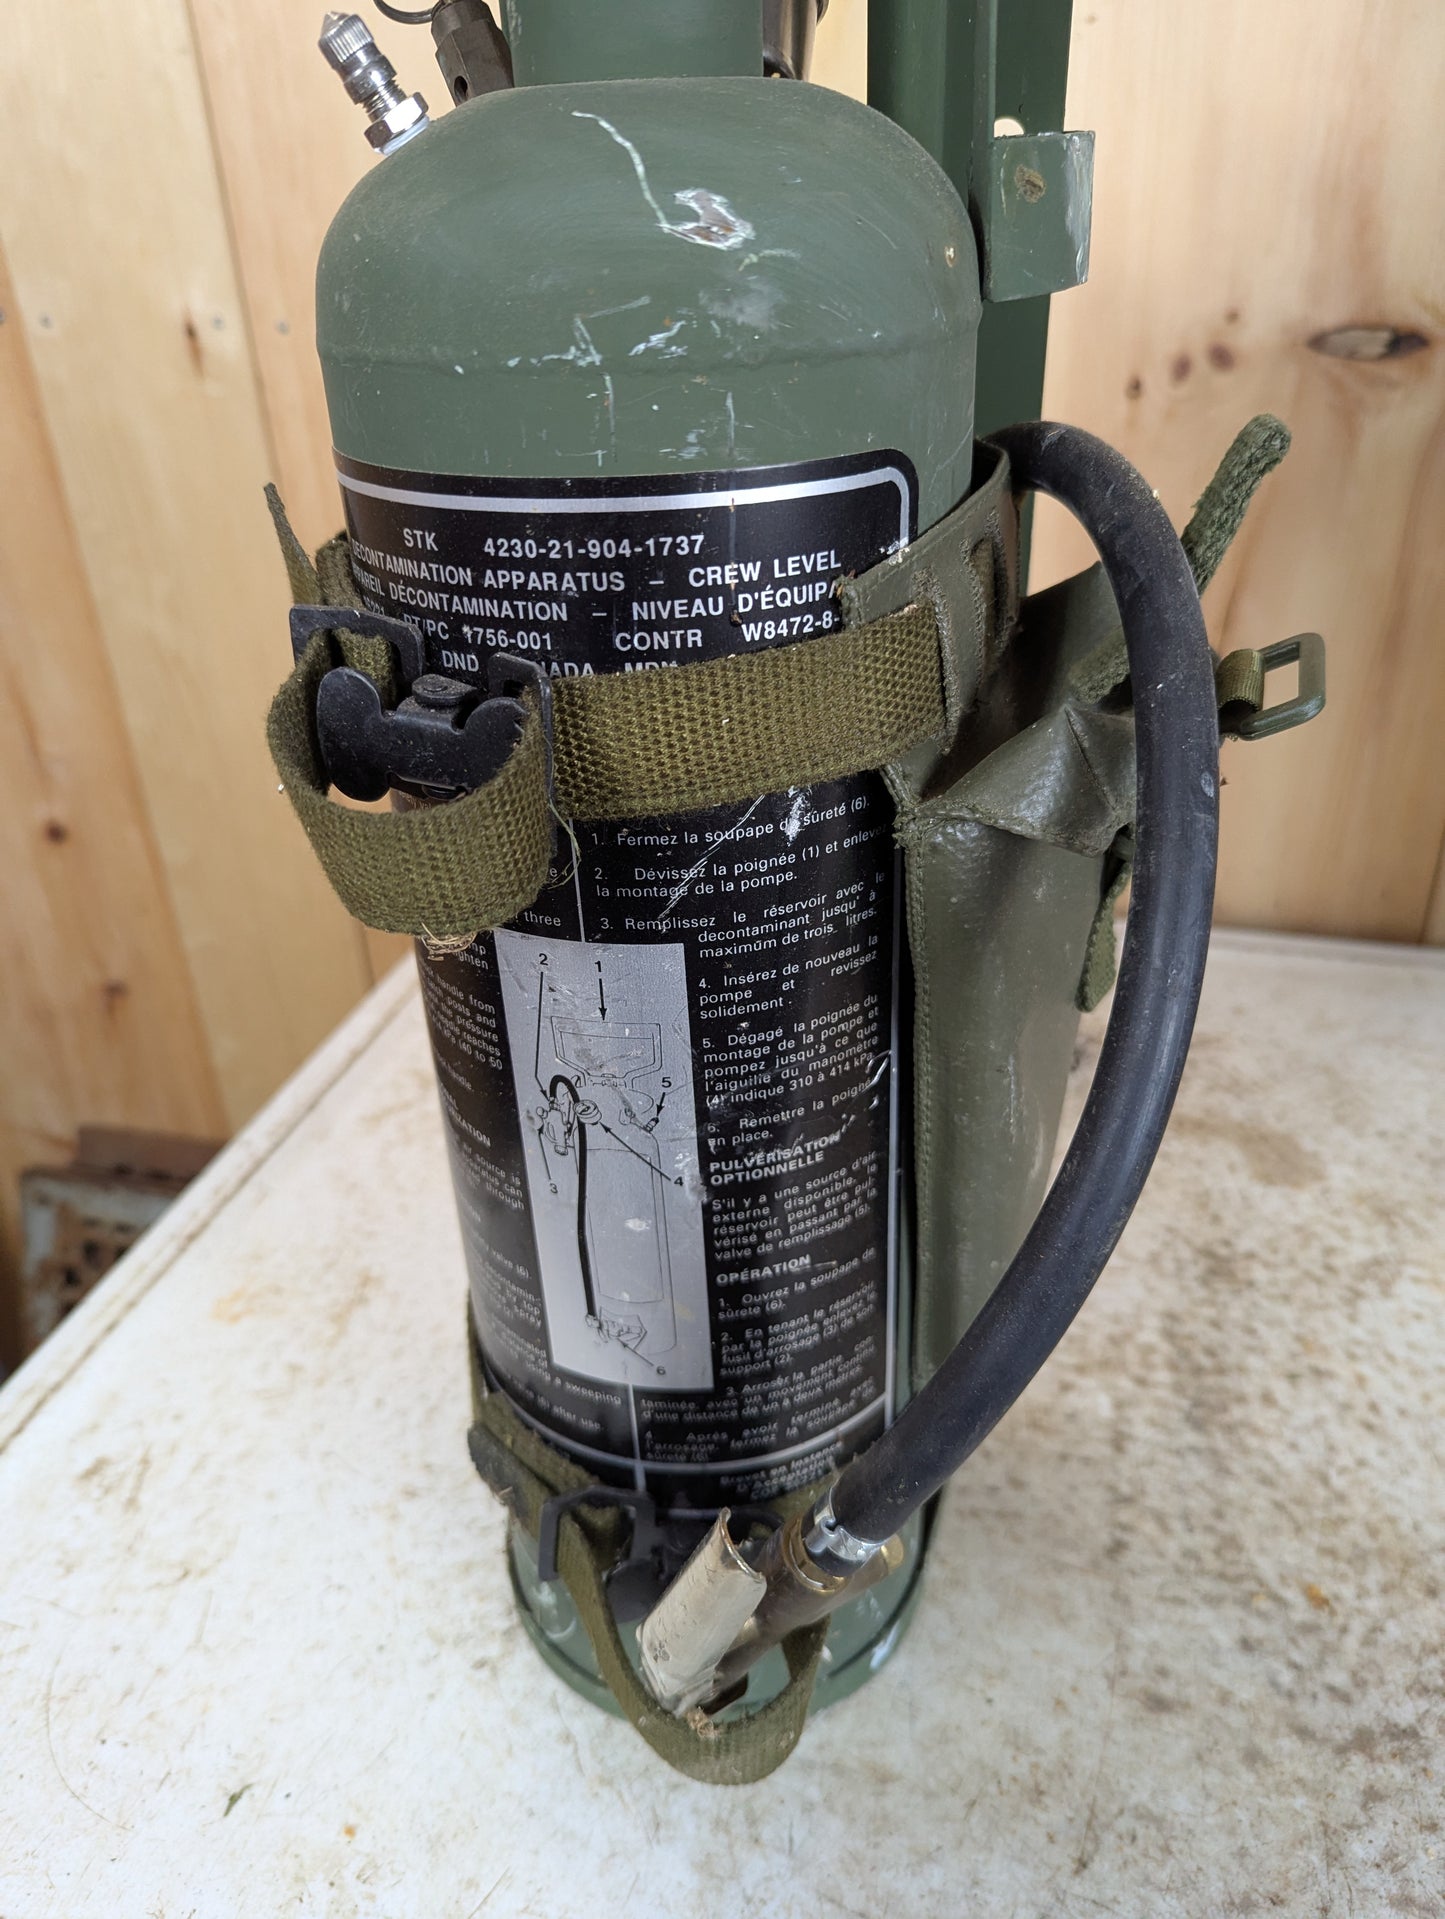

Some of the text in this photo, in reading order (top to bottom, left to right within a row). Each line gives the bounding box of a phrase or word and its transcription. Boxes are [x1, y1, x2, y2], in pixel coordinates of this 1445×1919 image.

[403, 527, 704, 559] STK 4230-21-904-1737
[352, 538, 841, 592] DECONTAMINATION APPARATUS CREW LEVEL
[389, 580, 567, 622] DÉCONTAMINATION
[632, 596, 723, 621] NIVEAU
[615, 629, 703, 651] CONTR
[442, 650, 479, 672] DND
[618, 833, 678, 846] Fermez
[685, 831, 698, 843] la
[705, 823, 774, 843] soupape
[803, 802, 846, 826] sûreté
[851, 796, 870, 813] (6).
[594, 867, 608, 880] 2.
[635, 867, 706, 880] Dévissez
[714, 863, 727, 876] la
[734, 853, 796, 876] poignée
[802, 845, 819, 861] (1)
[826, 841, 838, 854] et
[597, 871, 798, 900] la montage de la pompe.
[524, 910, 561, 927] three
[600, 917, 613, 929] 3.
[625, 917, 716, 934] Remplissez
[734, 911, 746, 923] le
[764, 893, 827, 918] réservoir
[836, 881, 864, 900] avec
[698, 914, 810, 942] decontaminant
[782, 932, 799, 945] de
[804, 922, 834, 940] trois
[539, 953, 602, 973] 2 1
[699, 935, 877, 989] 4. Insérez de nouveau la
[700, 950, 877, 1006] pompe et revissez
[469, 994, 496, 1015] from
[456, 1015, 499, 1042] pressure
[476, 1013, 496, 1028] and
[703, 994, 877, 1048] 5. Dégagé la poignée du
[704, 1006, 879, 1063] montage de la pompe et
[463, 1031, 502, 1057] reaches
[705, 1061, 766, 1079] pompez
[835, 1035, 848, 1048] ce
[857, 1022, 878, 1039] que
[781, 1068, 798, 1080] du
[809, 1035, 878, 1071] manomètre
[489, 1055, 503, 1071] 50
[661, 1077, 672, 1088] 5
[731, 1083, 784, 1103] indique
[790, 1076, 813, 1091] 310
[817, 1071, 825, 1082] à
[830, 1061, 850, 1076] 414
[739, 1106, 805, 1129] Remettre
[813, 1099, 824, 1111] la
[732, 1130, 773, 1146] place.
[674, 1176, 683, 1187] 4
[711, 1150, 824, 1185] OPTIONNELLE
[550, 1183, 558, 1195] 3
[774, 1185, 799, 1199] une
[806, 1167, 847, 1190] source
[713, 1206, 771, 1224] externe
[714, 1215, 779, 1235] réservoir
[787, 1204, 817, 1224] peut
[714, 1232, 758, 1248] vérisé
[765, 1228, 782, 1240] en
[789, 1208, 838, 1234] passant
[714, 1246, 752, 1261] valve
[757, 1242, 773, 1254] de
[778, 1214, 852, 1248] remplissage
[716, 1253, 812, 1287] OPÉRATION
[743, 1286, 790, 1304] Ouvrez
[810, 1257, 859, 1287] soupape
[745, 1327, 763, 1339] En
[656, 1365, 666, 1376] 6
